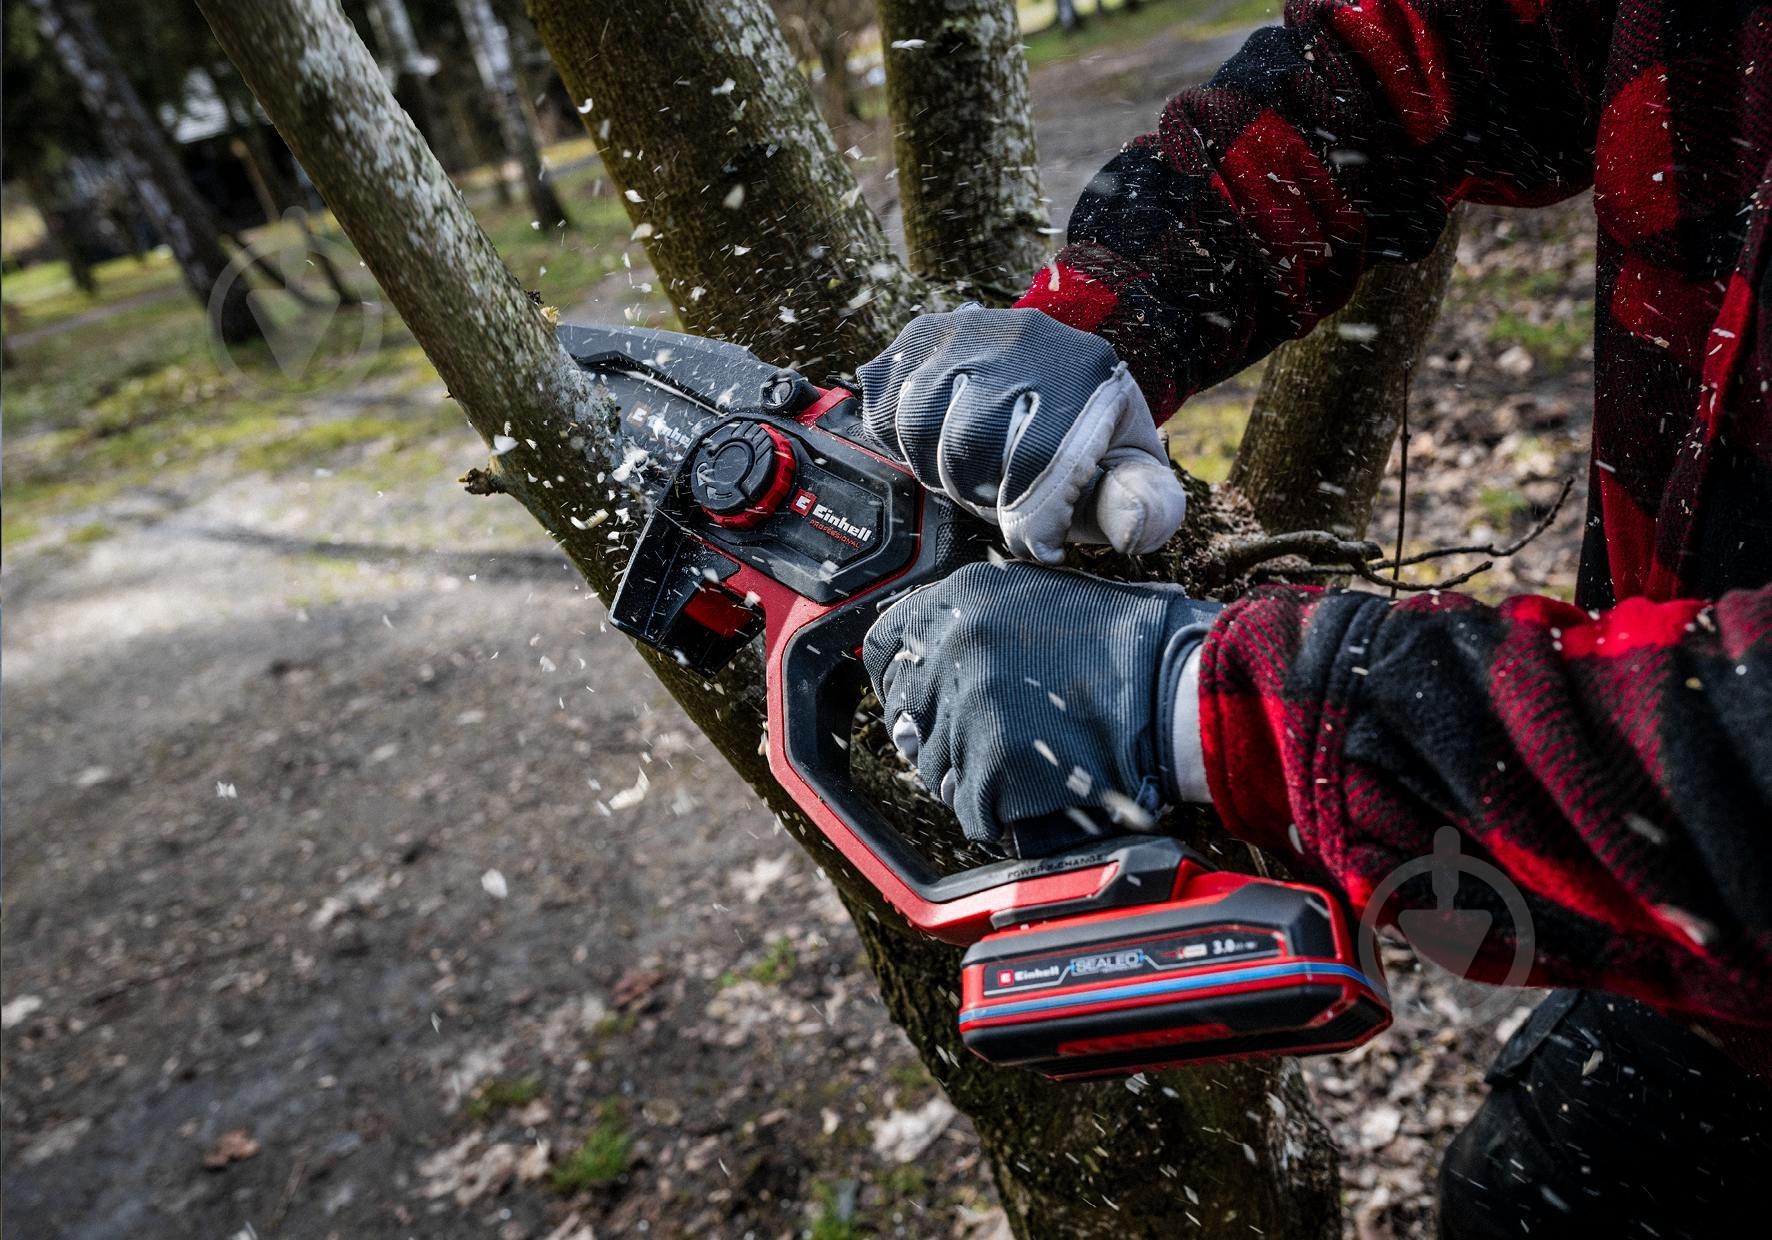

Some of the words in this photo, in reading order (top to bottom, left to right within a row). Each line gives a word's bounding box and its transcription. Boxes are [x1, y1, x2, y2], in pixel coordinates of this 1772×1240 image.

[808, 519, 861, 549] PROFESSIONAL
[812, 503, 873, 542] Einhell
[1007, 864, 1044, 879] POWER
[1014, 965, 1060, 981] Einhell
